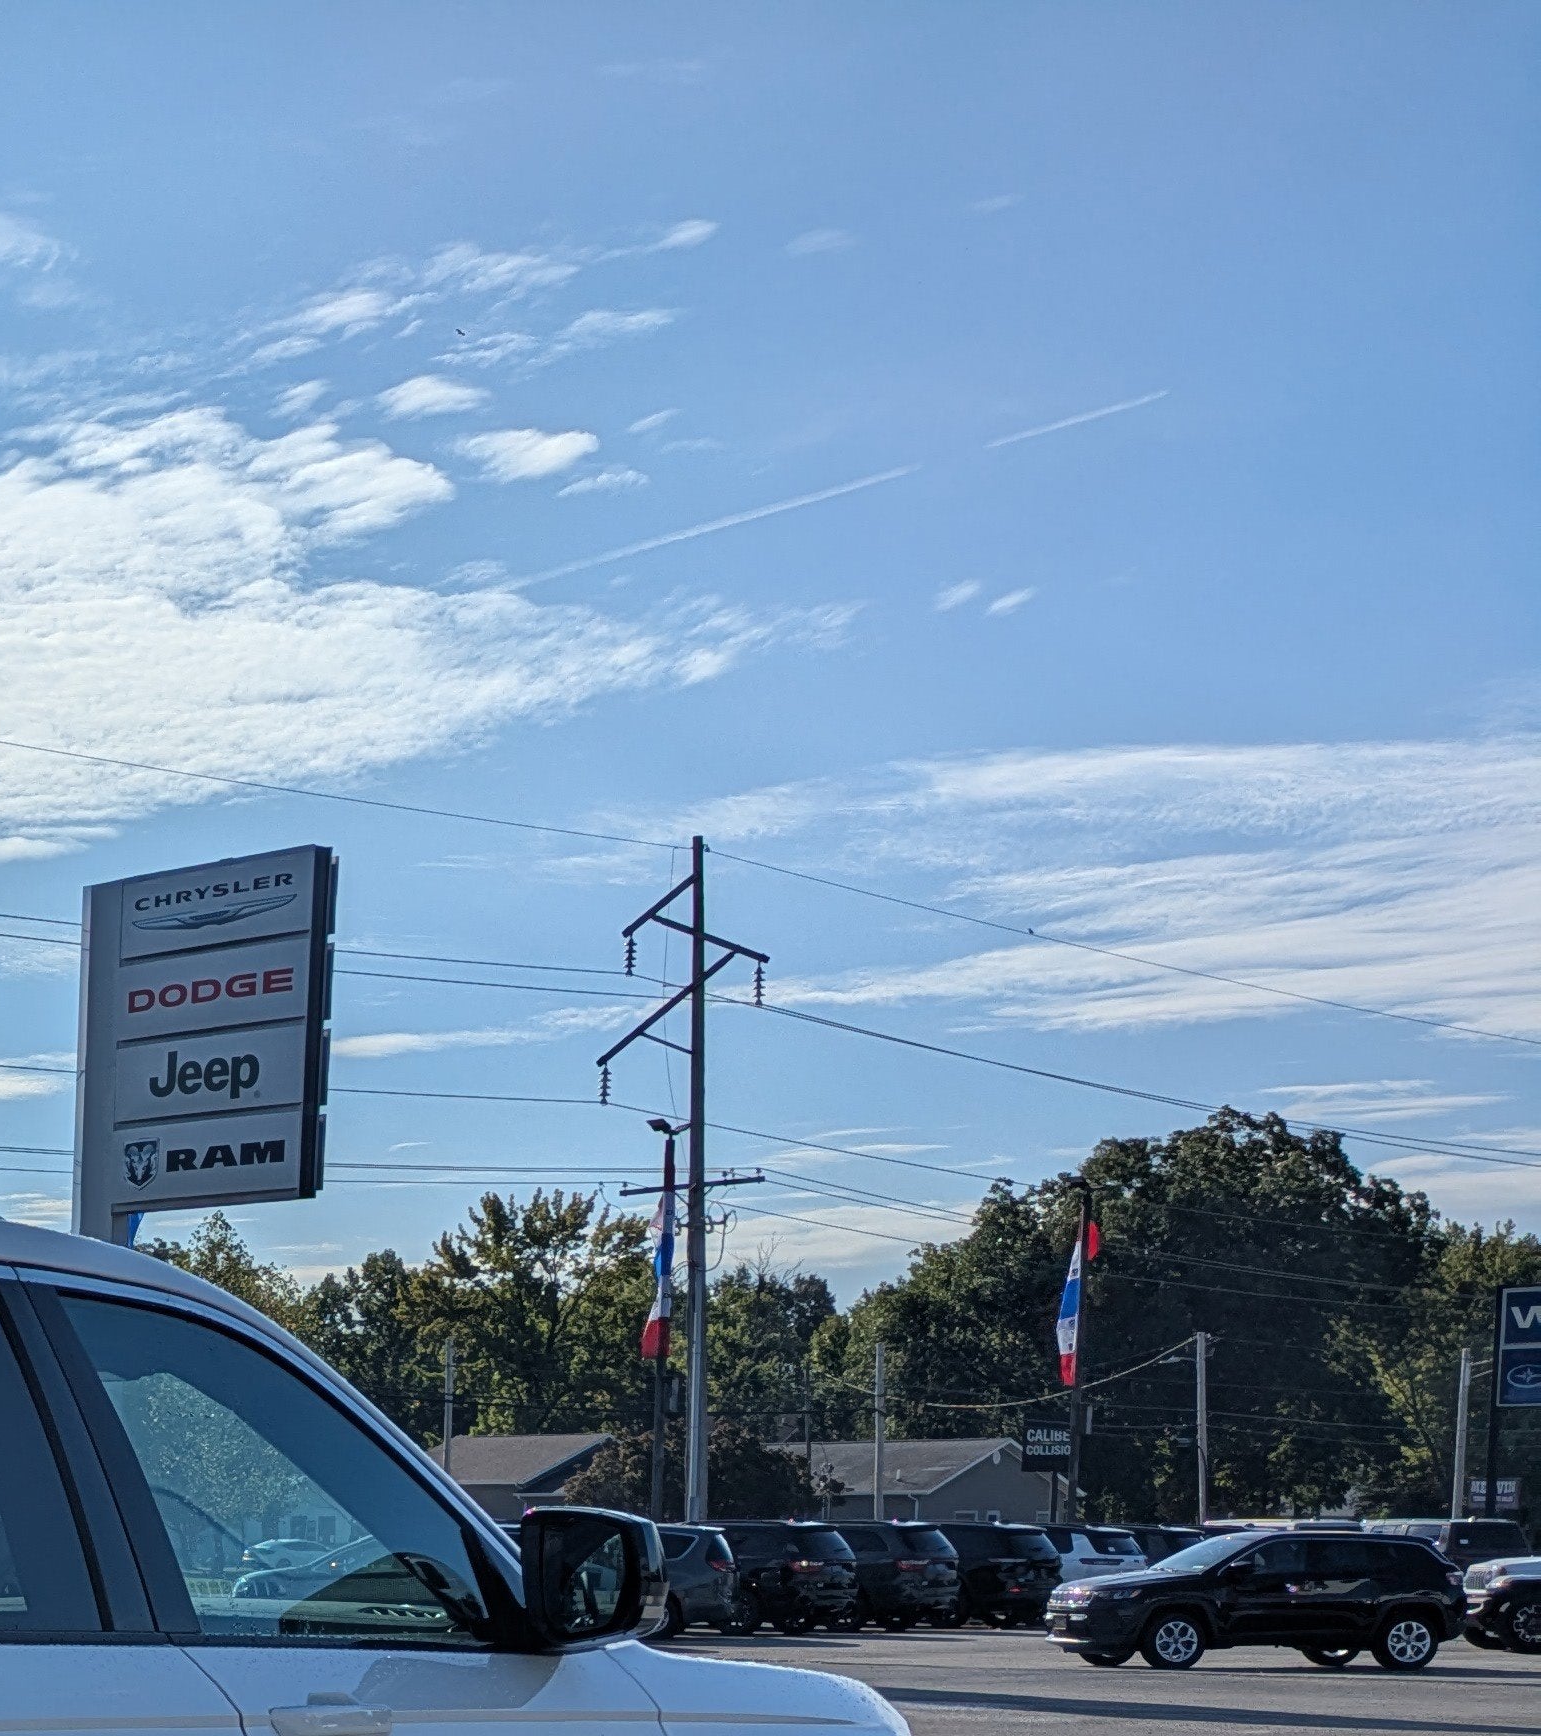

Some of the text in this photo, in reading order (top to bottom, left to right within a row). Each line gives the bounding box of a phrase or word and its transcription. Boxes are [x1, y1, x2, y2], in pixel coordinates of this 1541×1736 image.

[134, 872, 293, 911] CHRYSLER
[128, 967, 294, 1013] DODGE
[149, 1050, 260, 1099] Jeep
[166, 1139, 285, 1172] RAM
[1025, 1444, 1071, 1456] COLLISIO
[1026, 1428, 1071, 1442] CALIBE
